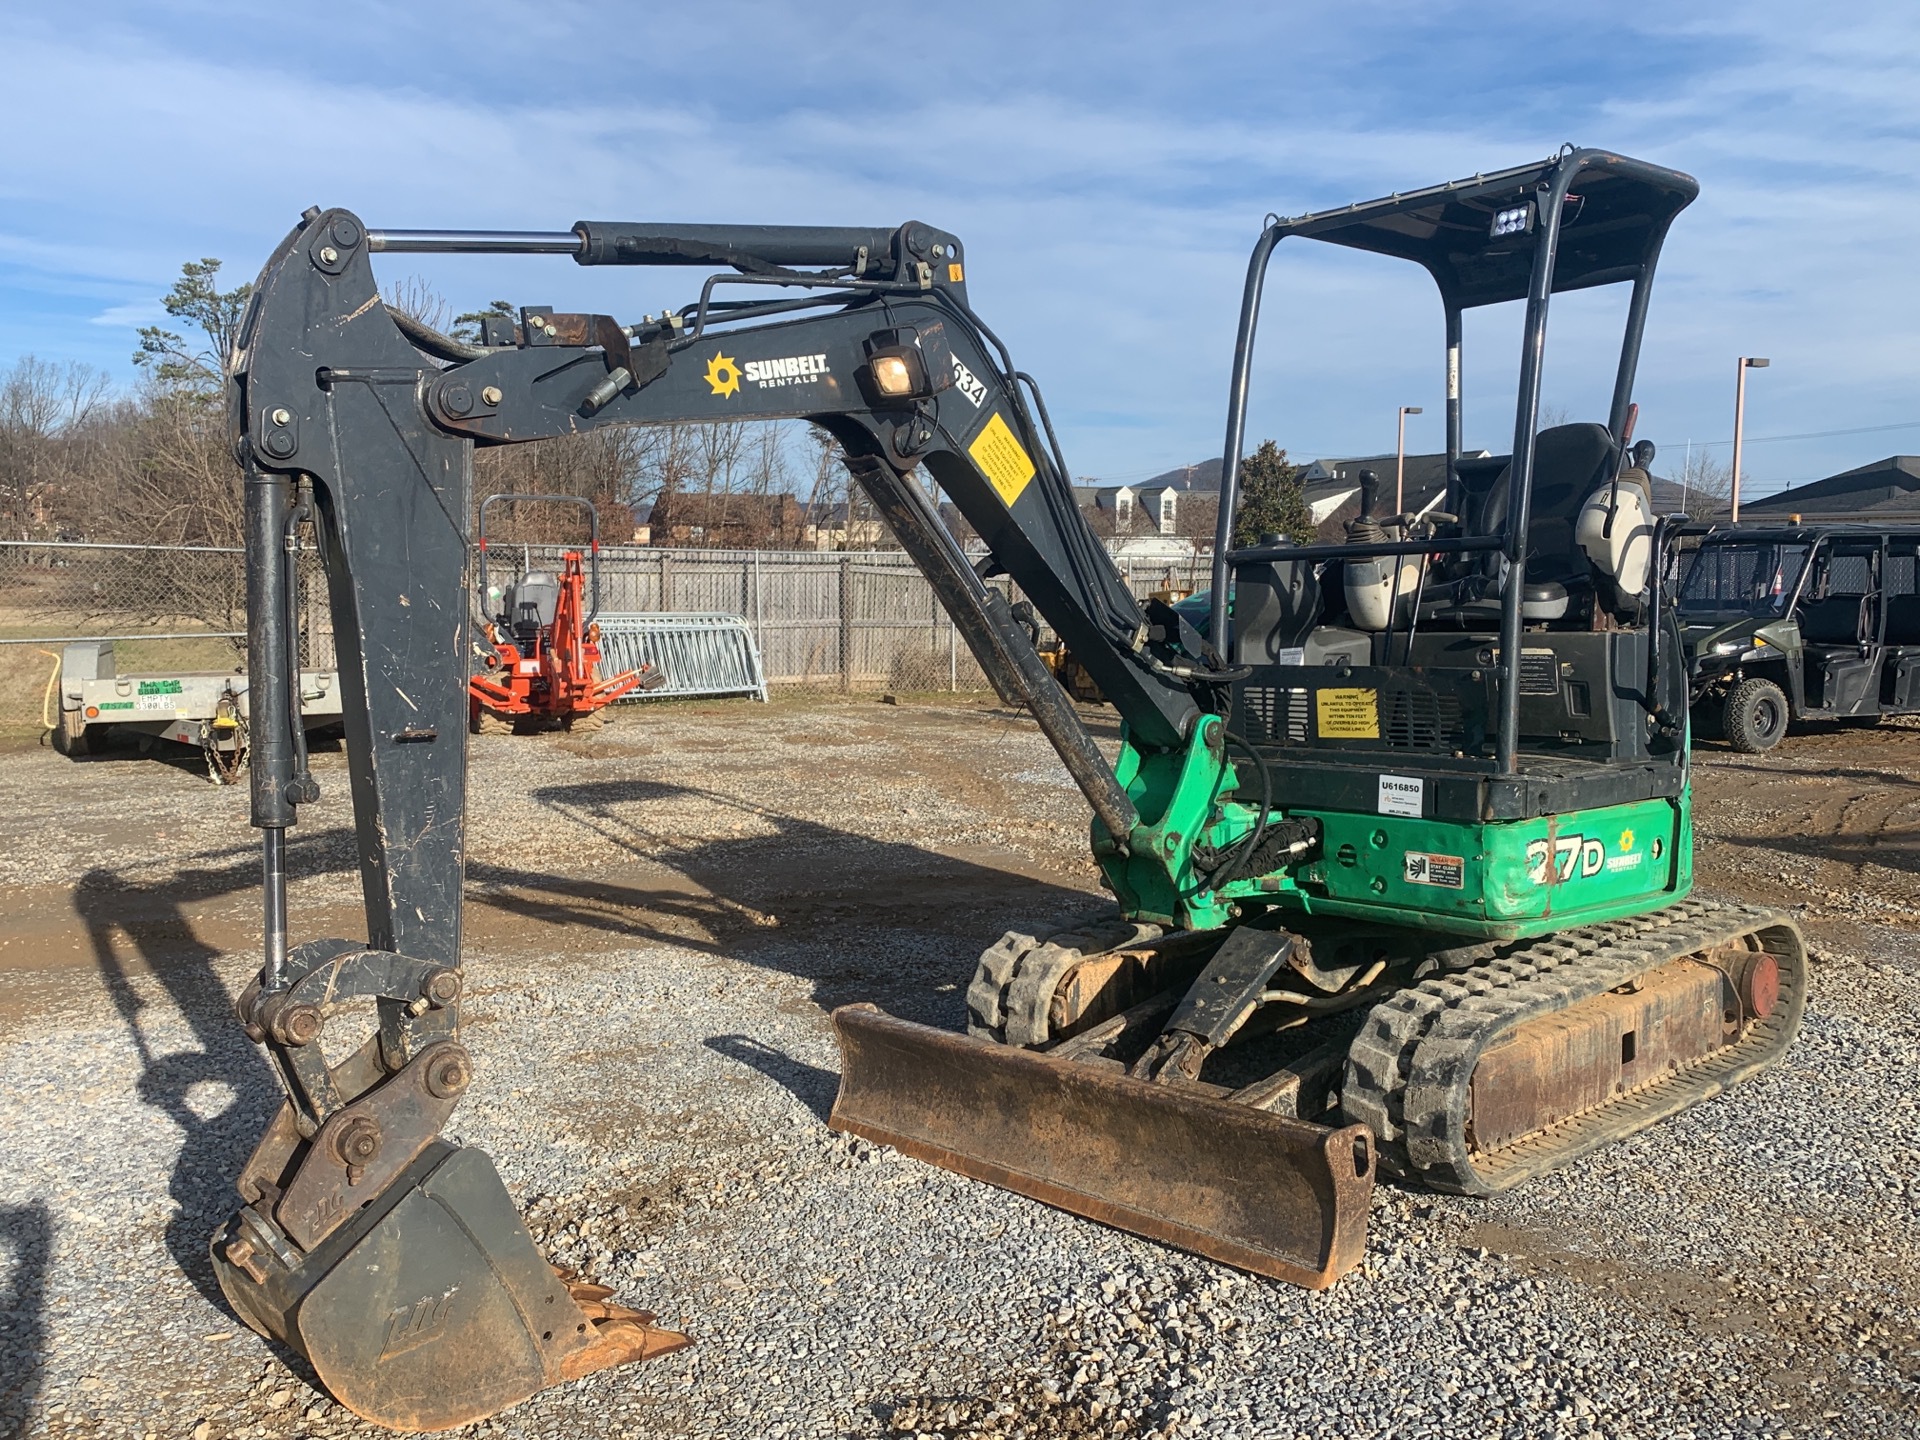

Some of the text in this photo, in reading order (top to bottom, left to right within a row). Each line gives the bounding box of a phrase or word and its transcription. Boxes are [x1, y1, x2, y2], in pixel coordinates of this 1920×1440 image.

[744, 354, 827, 382] SUNBELT
[759, 374, 818, 389] RENTALS
[1382, 781, 1420, 793] U616850
